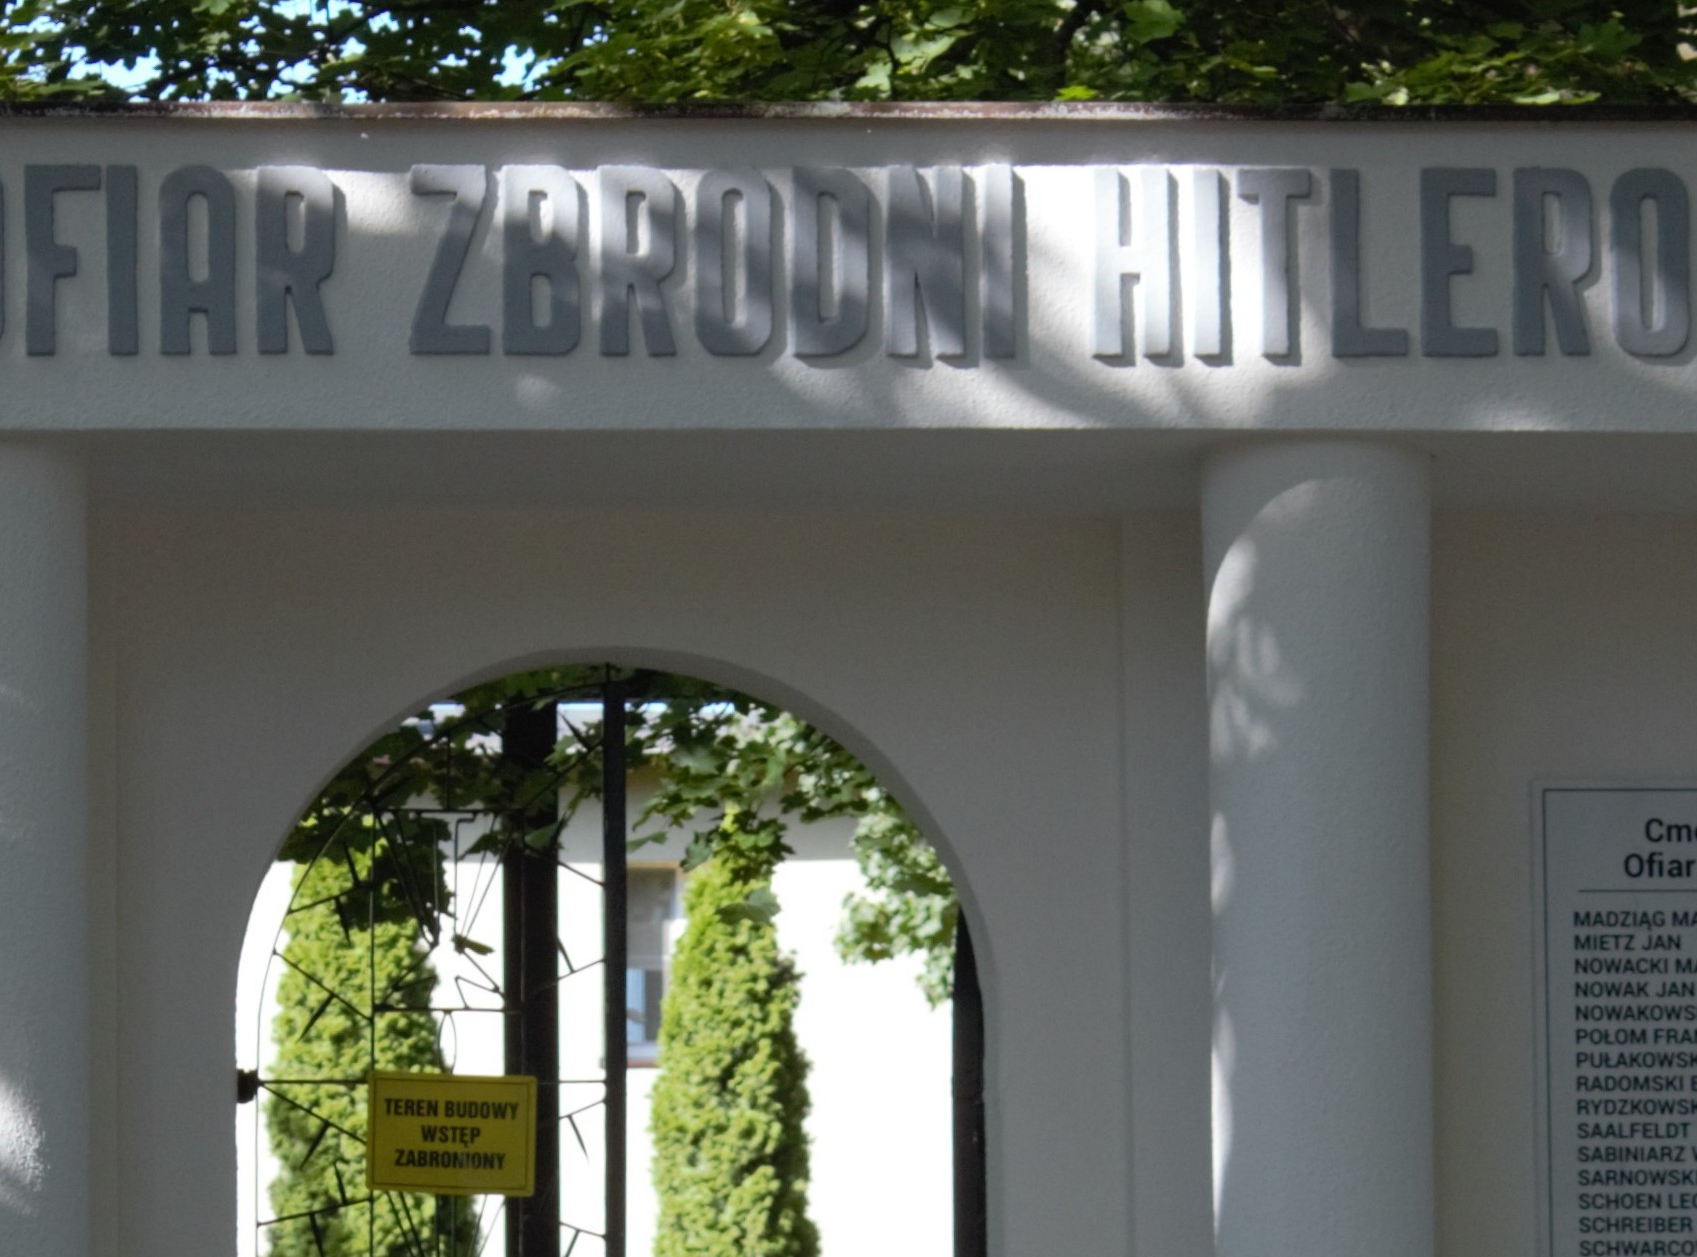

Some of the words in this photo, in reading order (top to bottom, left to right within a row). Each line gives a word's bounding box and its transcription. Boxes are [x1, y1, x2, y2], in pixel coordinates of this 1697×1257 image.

[407, 160, 1027, 362] ZBRODNI
[1624, 853, 1694, 878] Ofiar
[1573, 911, 1665, 931] MADZIĄG
[1574, 935, 1635, 951] MIETZ
[1643, 935, 1681, 950] JAN
[1574, 958, 1668, 974] NOWACKI
[1574, 982, 1649, 998] NOWAK
[1656, 982, 1694, 997] JAN
[1576, 1029, 1646, 1045] POŁOM
[1576, 1076, 1683, 1092] RADOMSKI
[384, 1098, 438, 1117] TEREN
[445, 1101, 519, 1120] BUDOWY
[421, 1125, 481, 1148] WSTĘP
[1578, 1123, 1691, 1139] SAALFELDT
[395, 1149, 506, 1170] ZABRONIONY
[1578, 1147, 1685, 1162] SABINIARZ
[1579, 1193, 1661, 1209] SCHOEN
[1579, 1217, 1693, 1233] SCHREIBER
